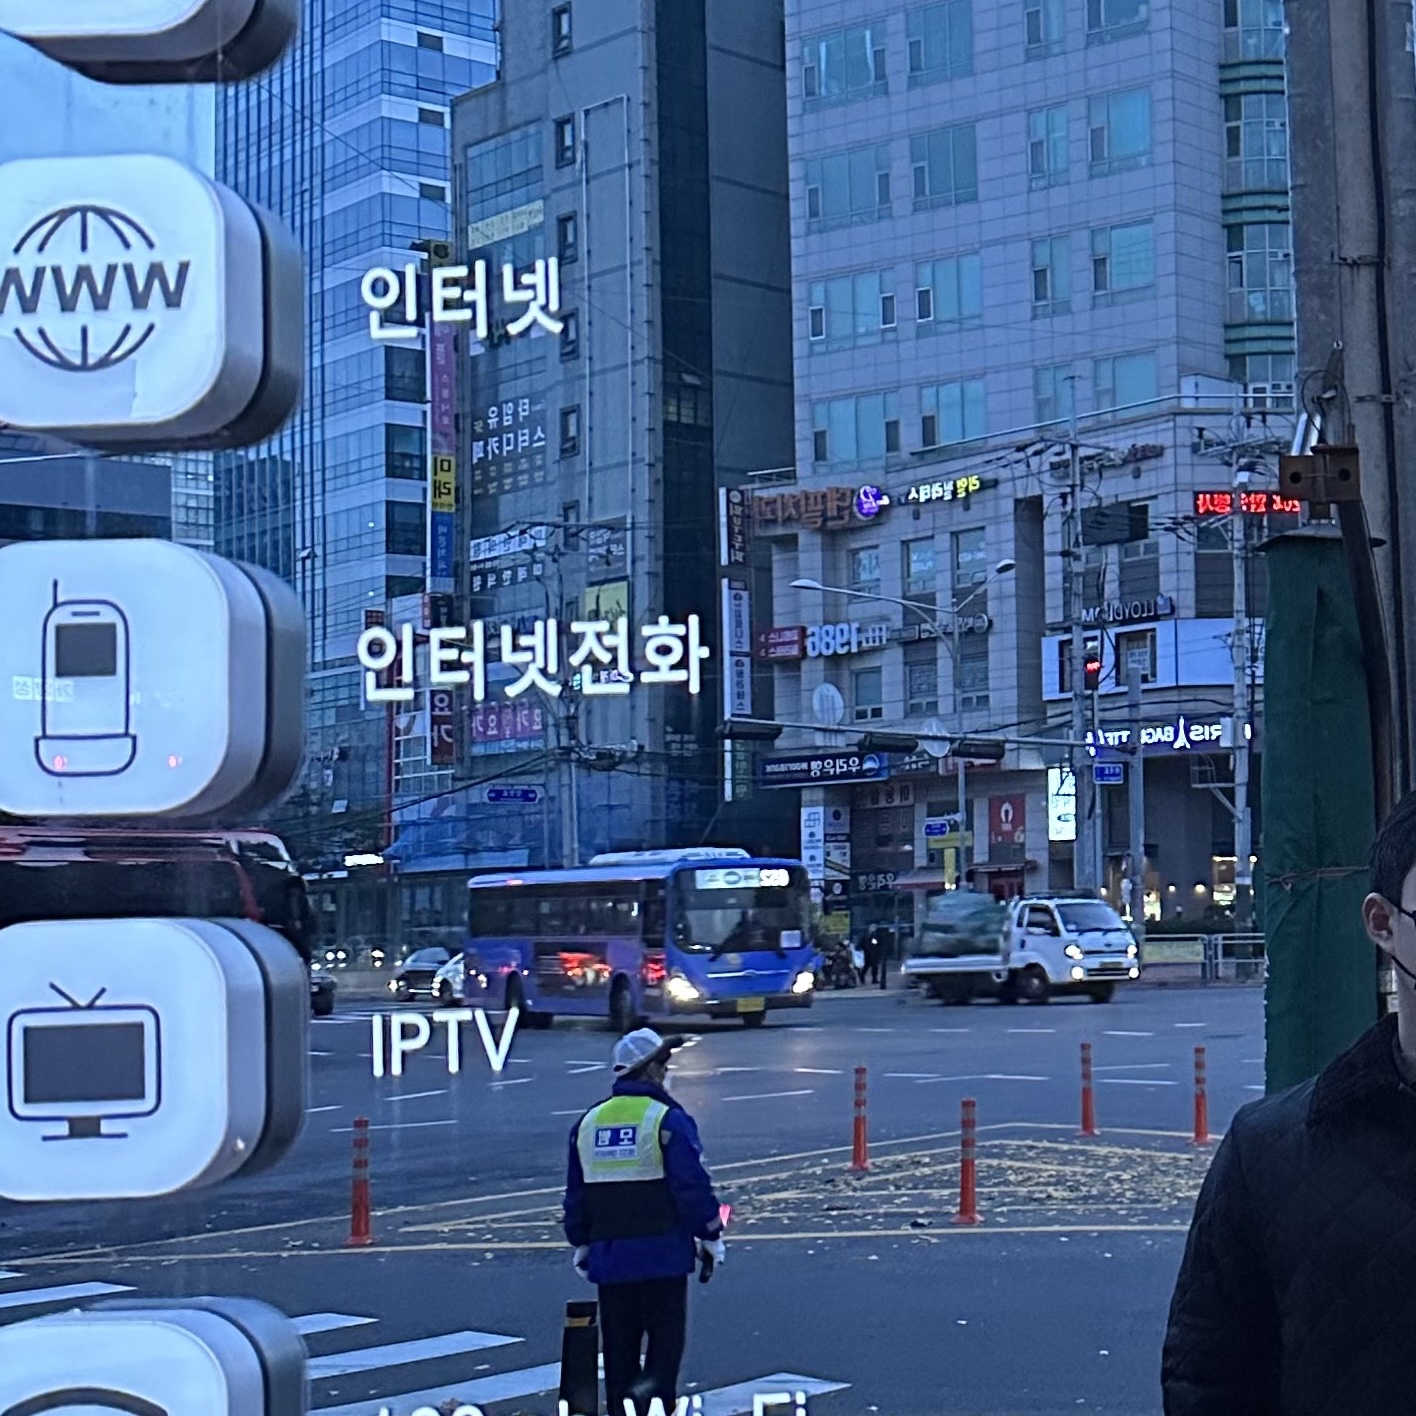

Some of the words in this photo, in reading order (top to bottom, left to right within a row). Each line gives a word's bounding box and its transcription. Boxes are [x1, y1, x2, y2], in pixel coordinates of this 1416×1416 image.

[361, 257, 564, 338] 인터넷
[357, 614, 710, 701] 인터넷전화
[370, 1008, 519, 1077] IPTV
